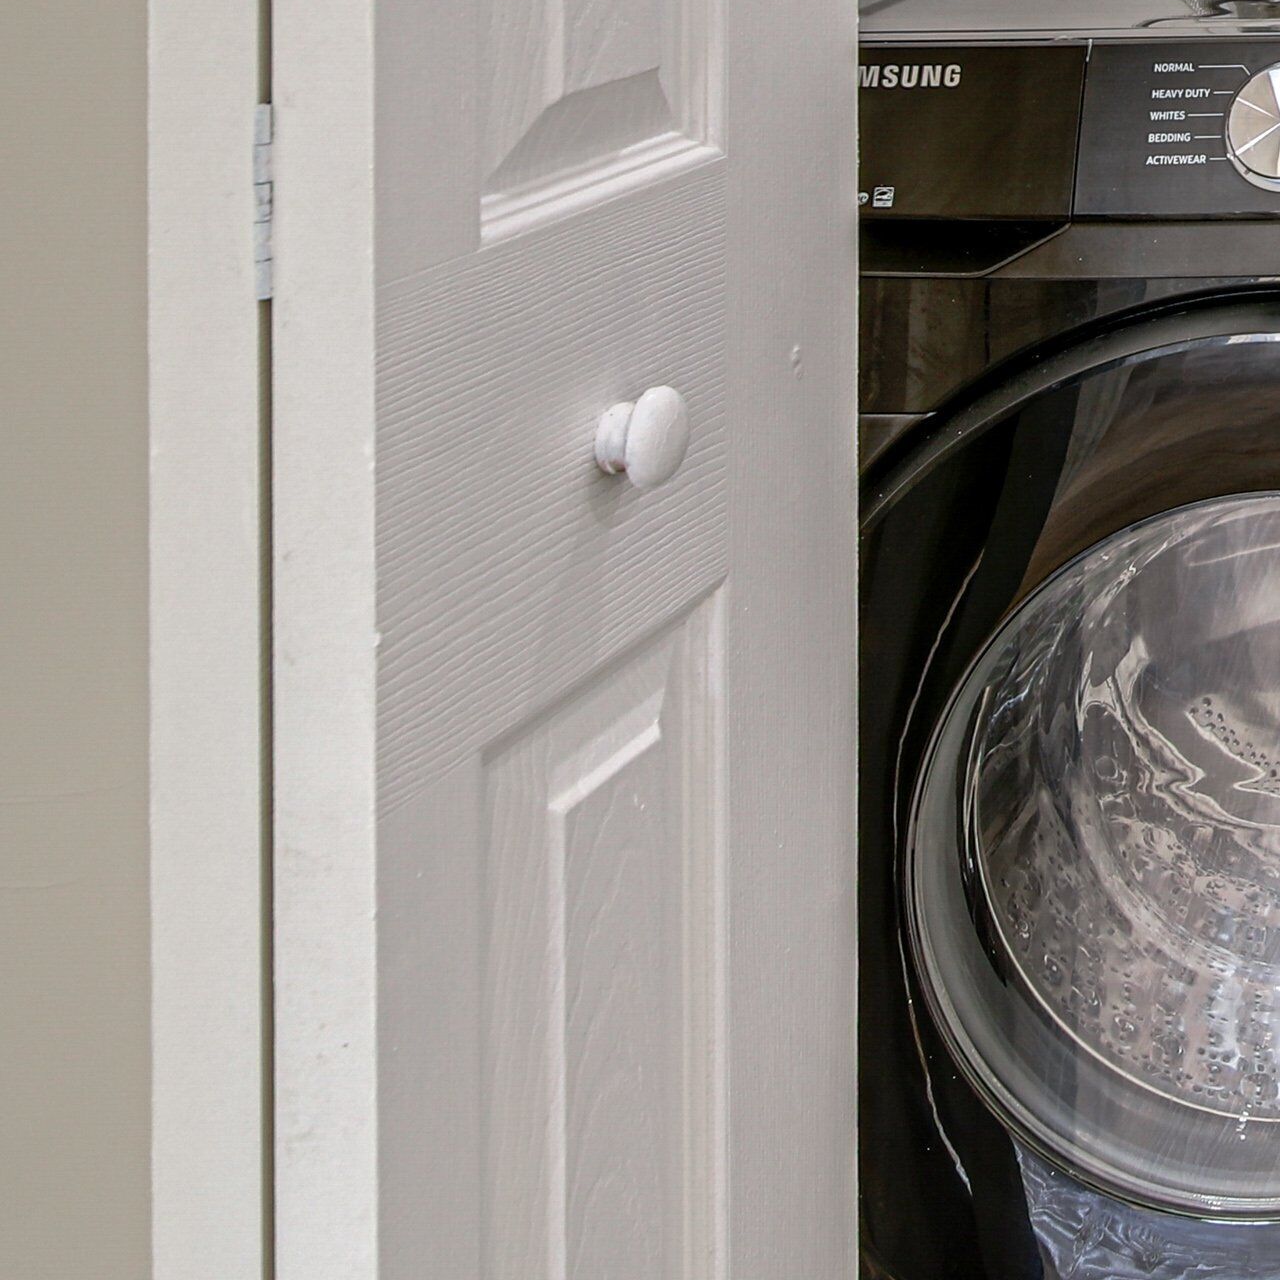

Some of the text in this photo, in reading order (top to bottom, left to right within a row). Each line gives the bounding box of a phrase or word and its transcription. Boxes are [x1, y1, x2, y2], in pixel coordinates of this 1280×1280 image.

[1154, 63, 1194, 72] NORMAL
[858, 64, 962, 88] MSUNG
[1152, 88, 1210, 98] HEAVY DUTY
[1150, 111, 1185, 120] WHITES
[1148, 132, 1191, 143] BEDDING
[1146, 154, 1206, 165] ACTIVEWEAR
